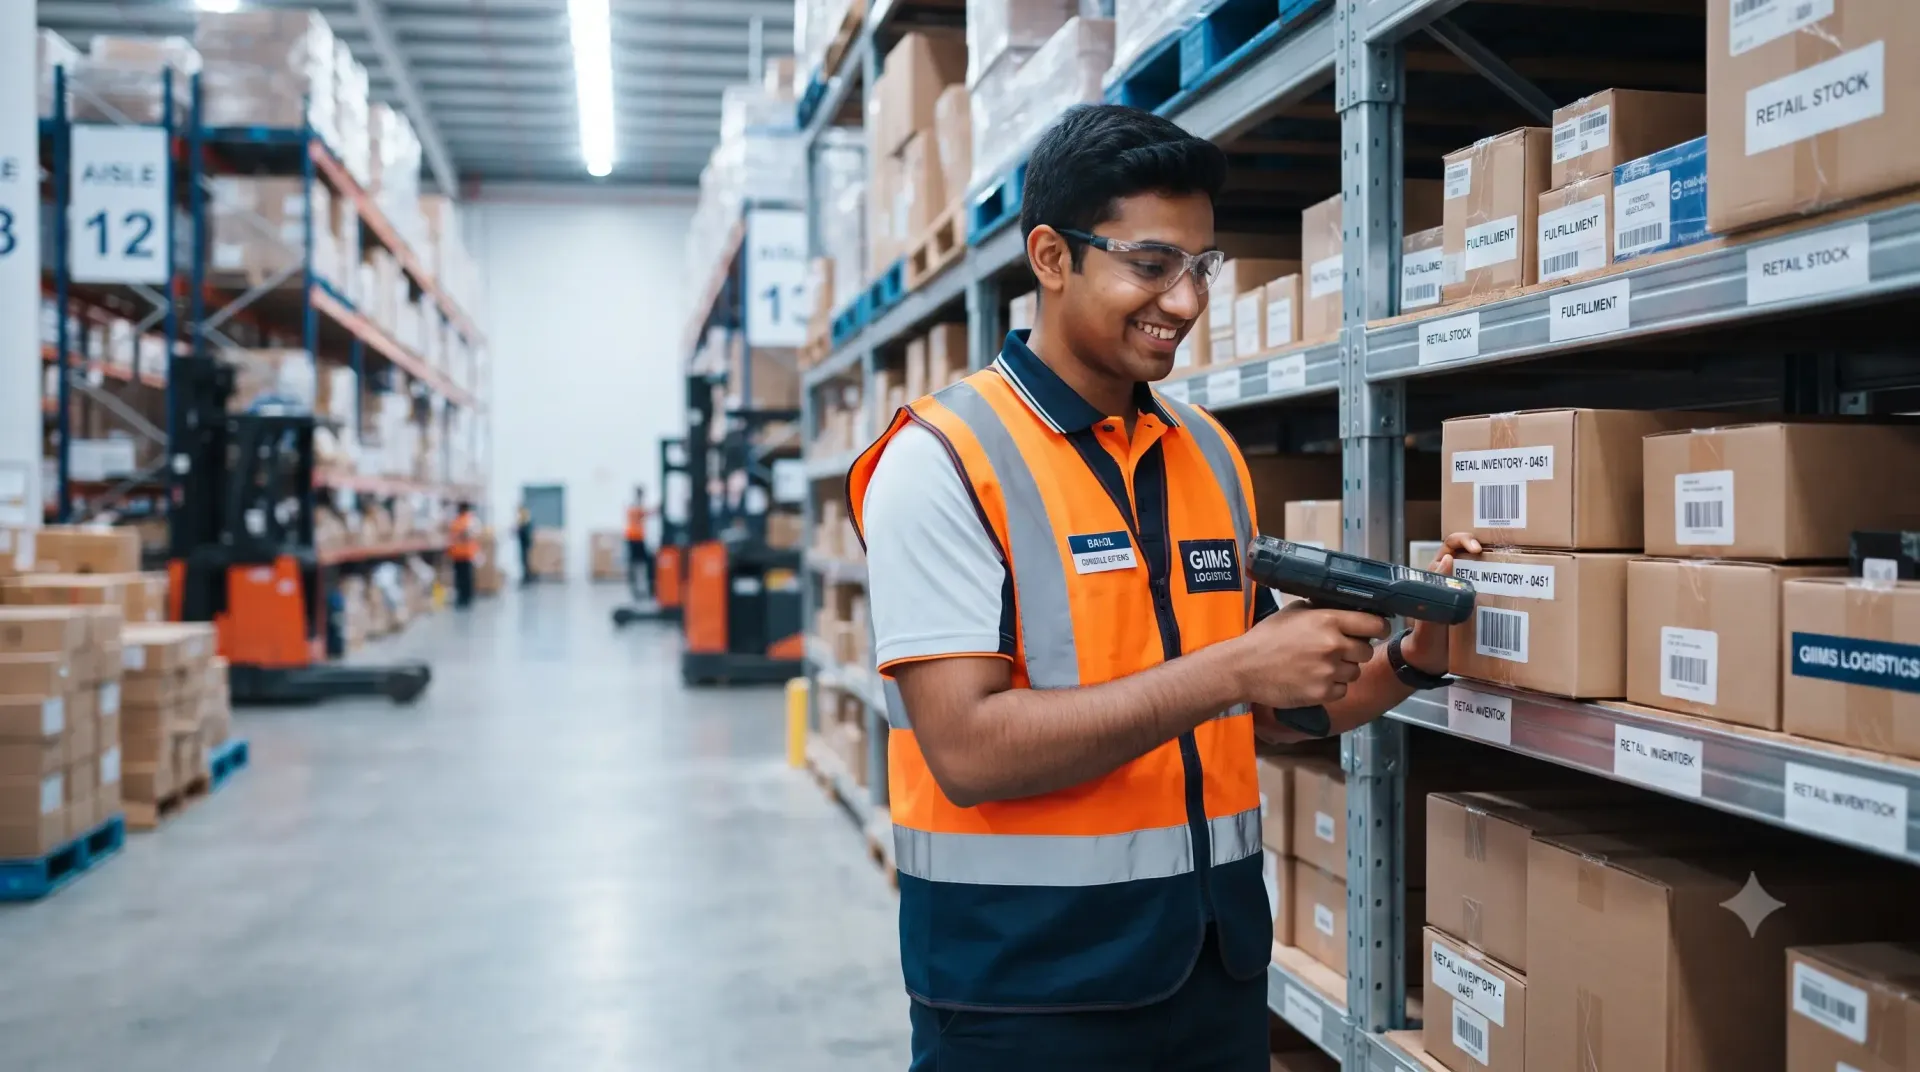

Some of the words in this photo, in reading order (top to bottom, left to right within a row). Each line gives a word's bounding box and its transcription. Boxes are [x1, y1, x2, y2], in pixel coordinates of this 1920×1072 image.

[1756, 94, 1808, 128] RETAIL
[1812, 71, 1870, 107] STOCK
[86, 208, 153, 258] 12
[1466, 227, 1515, 250] FULFILLMENT
[1544, 214, 1598, 242] FULFILLMENT
[1762, 257, 1803, 277] RETAIL
[1806, 246, 1850, 268] STOCK
[1561, 295, 1617, 319] FULFILLMENT
[1426, 333, 1448, 346] RETAIL
[1449, 327, 1472, 341] STOCK
[1455, 460, 1480, 471] RETAIL
[1481, 457, 1523, 470] INVENTORY
[1529, 456, 1548, 468] 0451
[1189, 549, 1232, 570] GIIMS
[1194, 571, 1232, 582] LOGISTICS
[1455, 568, 1480, 582] RETAIL
[1481, 571, 1524, 586] INVENTORY
[1530, 575, 1549, 588] 0451
[1840, 649, 1920, 679] LOGISTICS
[1454, 700, 1474, 714] RETAIL
[1620, 738, 1647, 757] RETAIL
[1793, 781, 1829, 803] RETAIL
[1433, 951, 1456, 975] RETAIL
